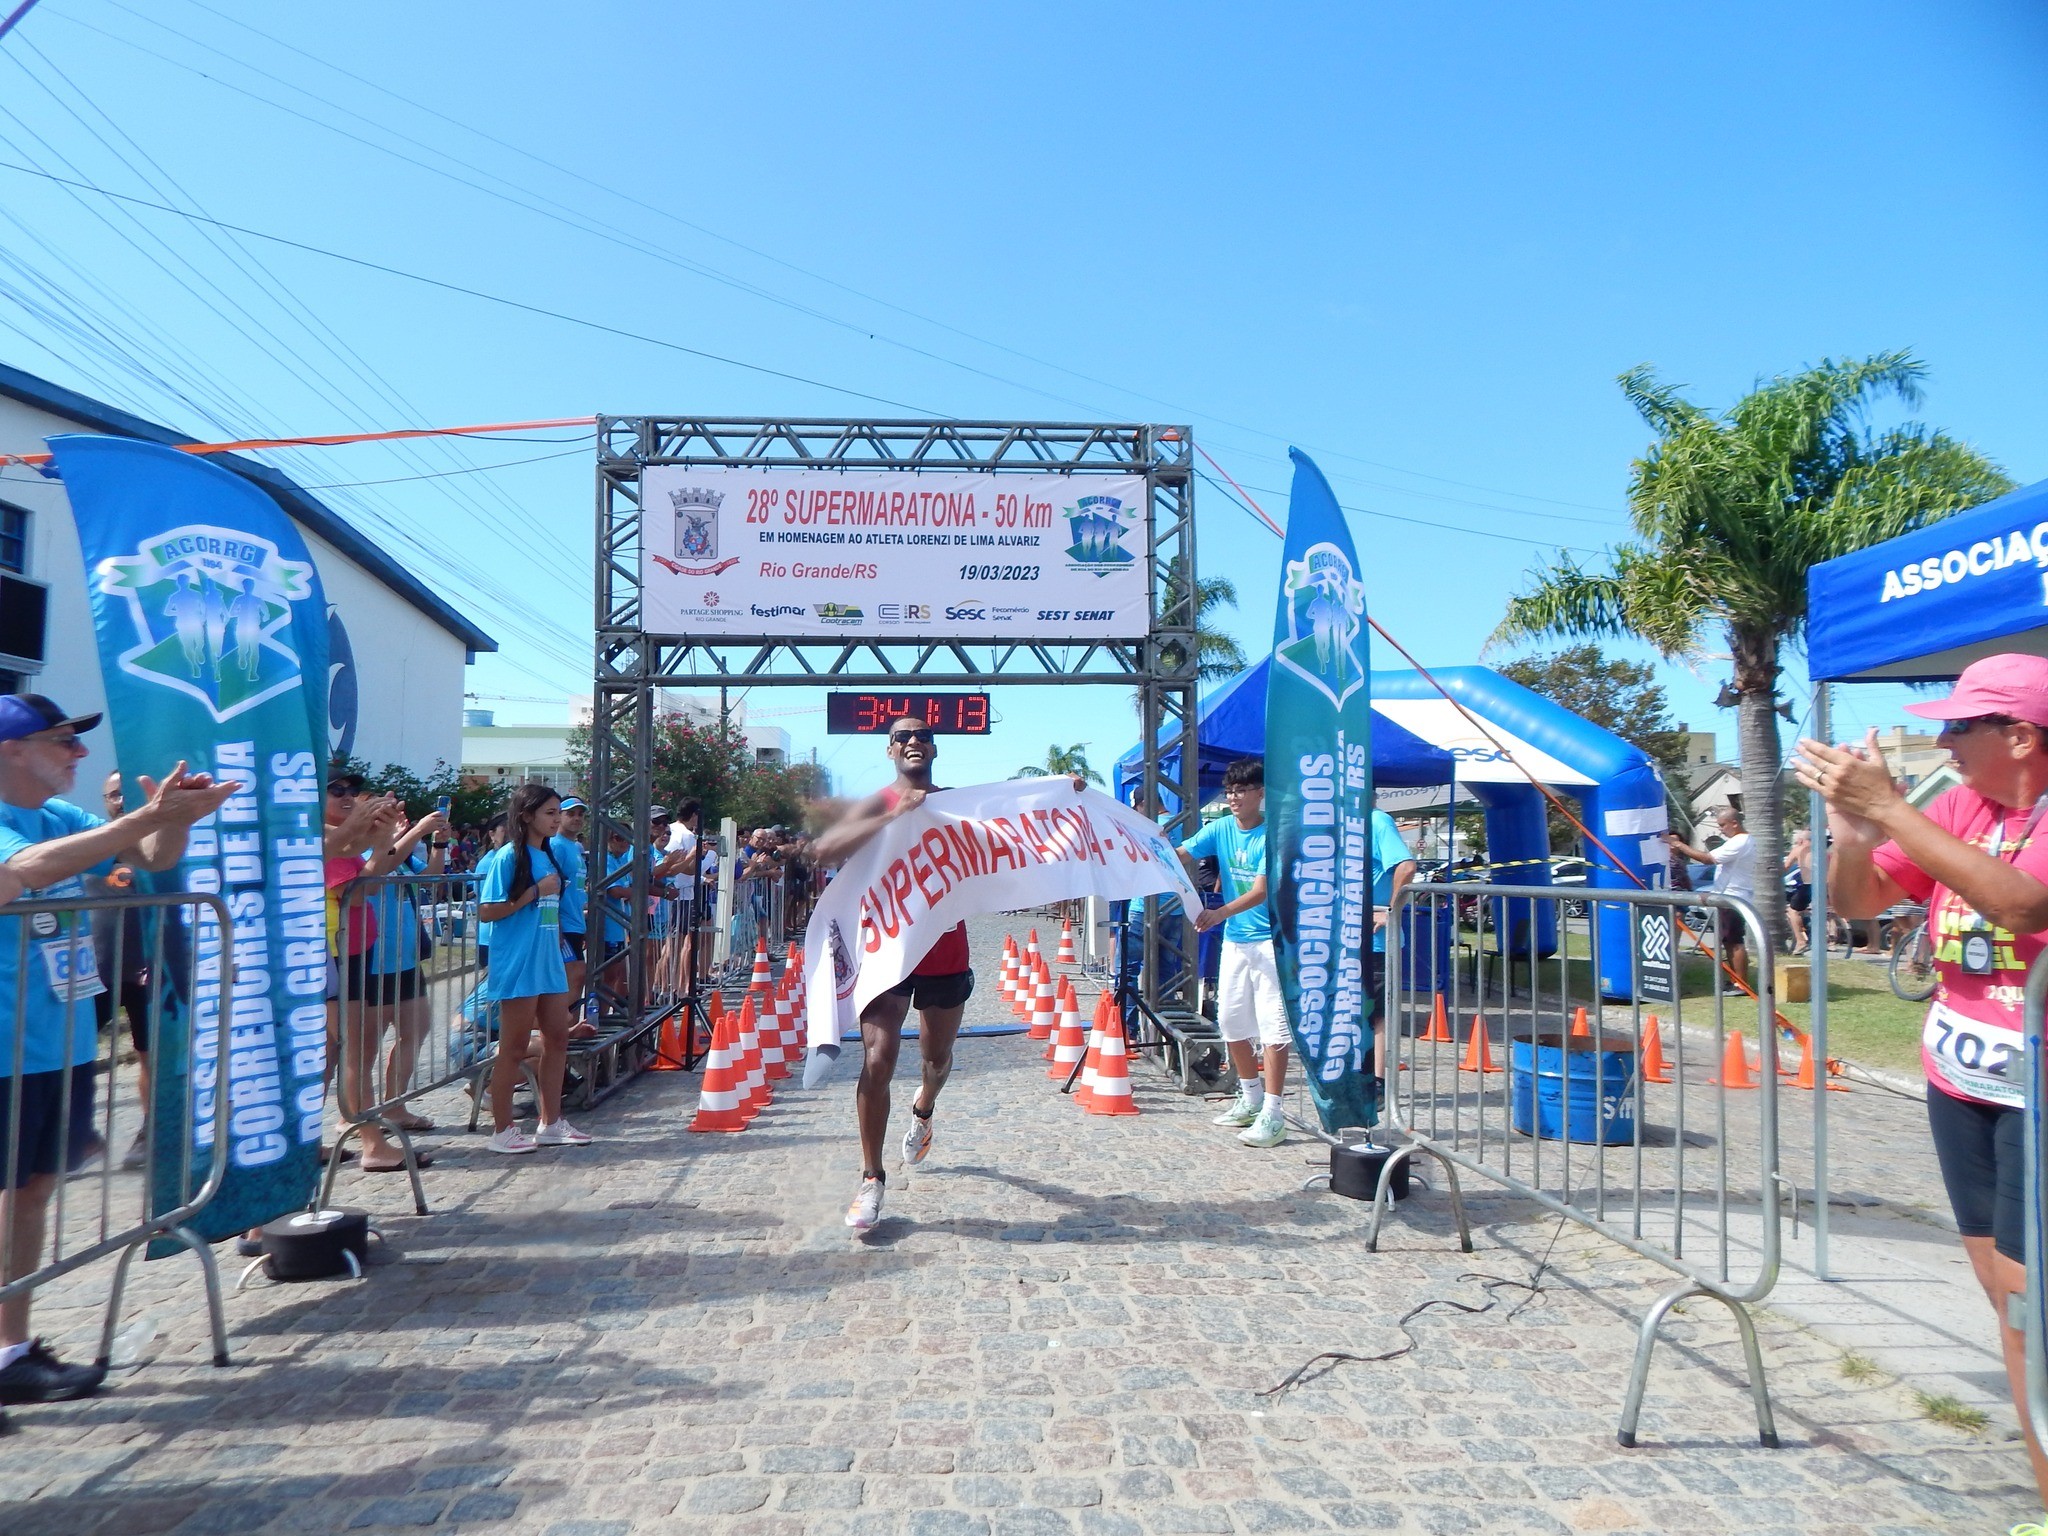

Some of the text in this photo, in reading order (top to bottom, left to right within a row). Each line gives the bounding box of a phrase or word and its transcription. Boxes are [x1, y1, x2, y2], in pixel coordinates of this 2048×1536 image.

[746, 489, 779, 523] 28º
[784, 490, 976, 527] SUPERMARATONA
[995, 494, 1018, 528] 50
[1023, 494, 1052, 528] km
[759, 532, 1040, 547] EM HOMENAGEM AO ATLETA LORENZI DE LIMA ALVARIZ
[164, 536, 256, 562] ACORRG
[760, 562, 877, 579] Rio Grande/RS
[959, 565, 1040, 581] 19/03/2023
[680, 608, 710, 616] PARTAGE
[750, 603, 806, 618] festimar
[908, 604, 931, 619] RS
[945, 607, 986, 620] Sesc
[1037, 610, 1115, 621] SEST SENAT
[820, 617, 863, 625] Cootracam
[1447, 747, 1513, 763] esc
[1346, 743, 1366, 789] RS
[271, 751, 320, 804] RS
[1300, 754, 1335, 825] DOS
[860, 804, 1106, 953] SUPERMARATONA
[278, 836, 328, 996] GRANDE
[216, 741, 288, 1167] CORREDORES DE RUA
[290, 1003, 327, 1077] RIO
